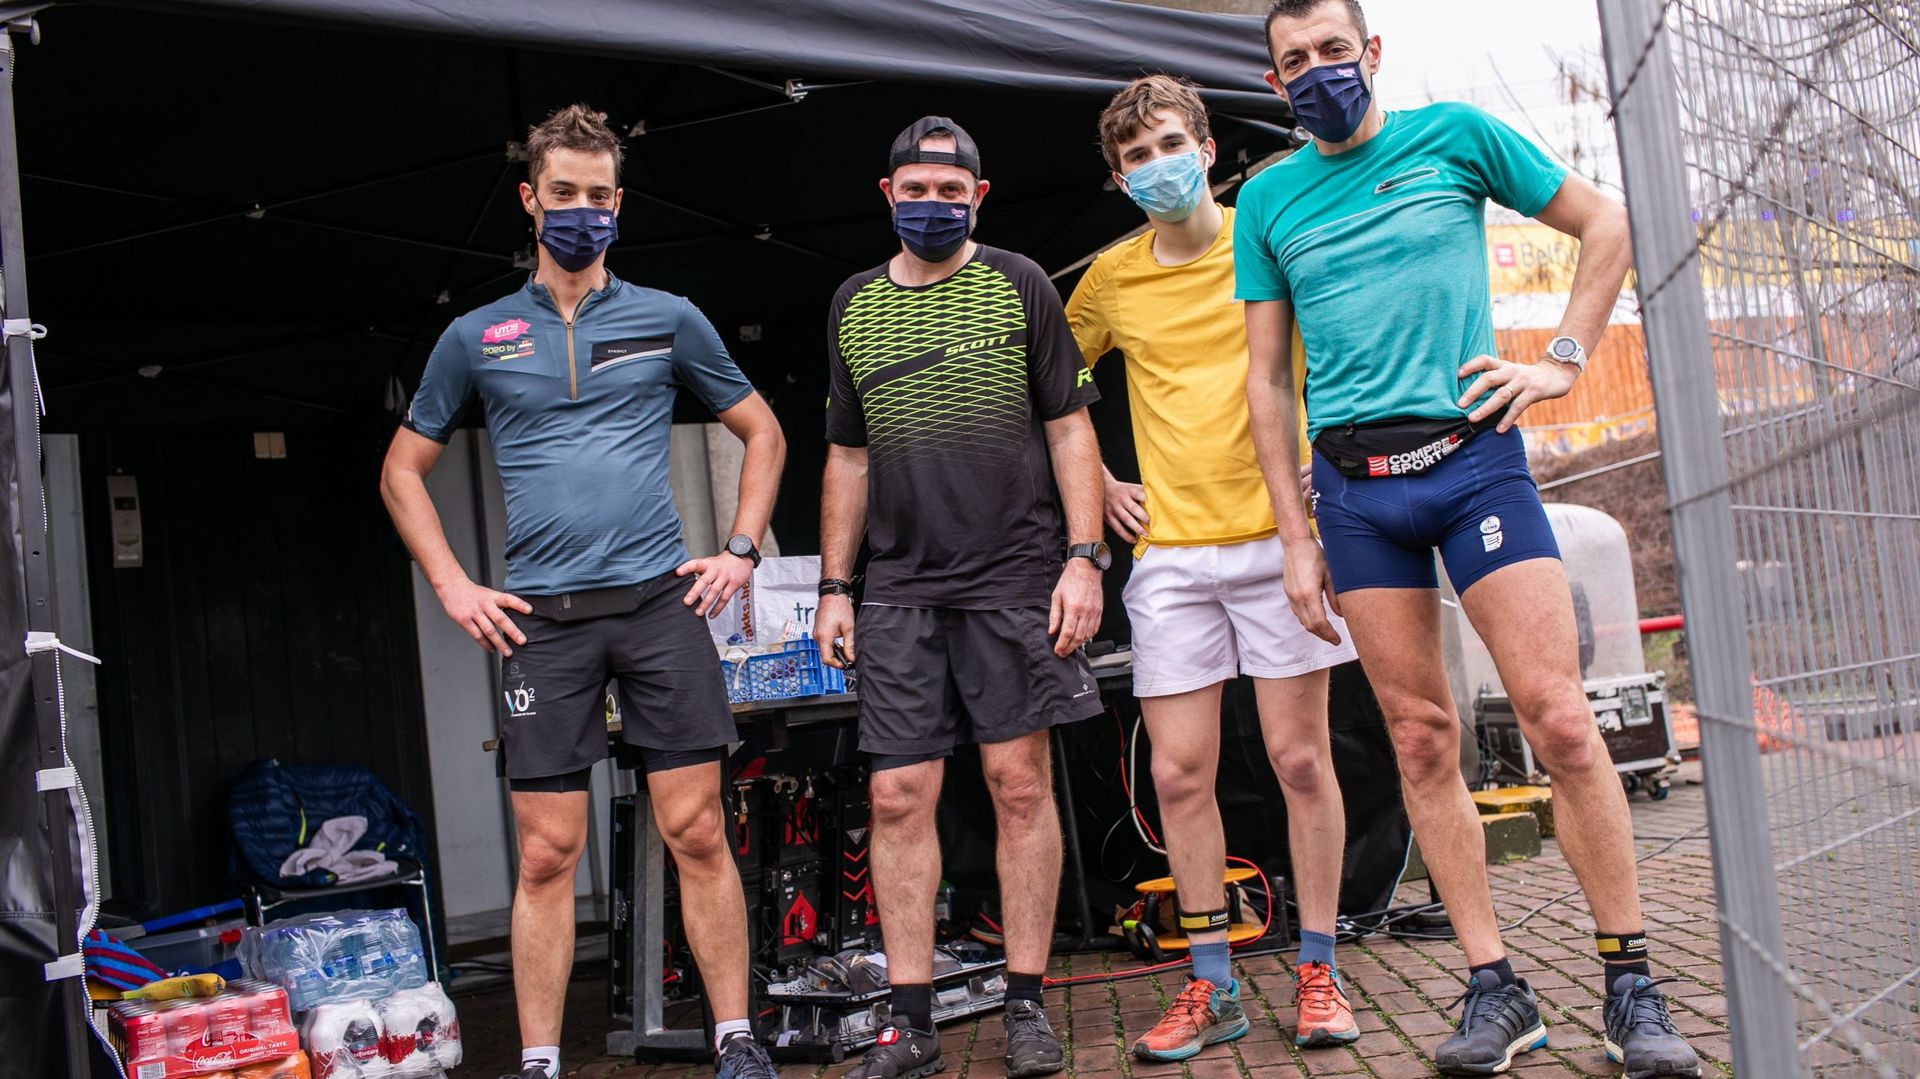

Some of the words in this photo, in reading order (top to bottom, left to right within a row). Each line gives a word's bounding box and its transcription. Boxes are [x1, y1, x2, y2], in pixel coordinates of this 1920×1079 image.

[482, 345, 506, 355] 2020
[506, 344, 516, 352] by
[944, 335, 1010, 357] SCOTT
[1077, 367, 1093, 388] R
[1389, 437, 1451, 465] COMPRE
[1390, 449, 1443, 475] SPORT
[239, 1045, 267, 1054] ORIGINAL
[268, 1041, 287, 1049] TASTE
